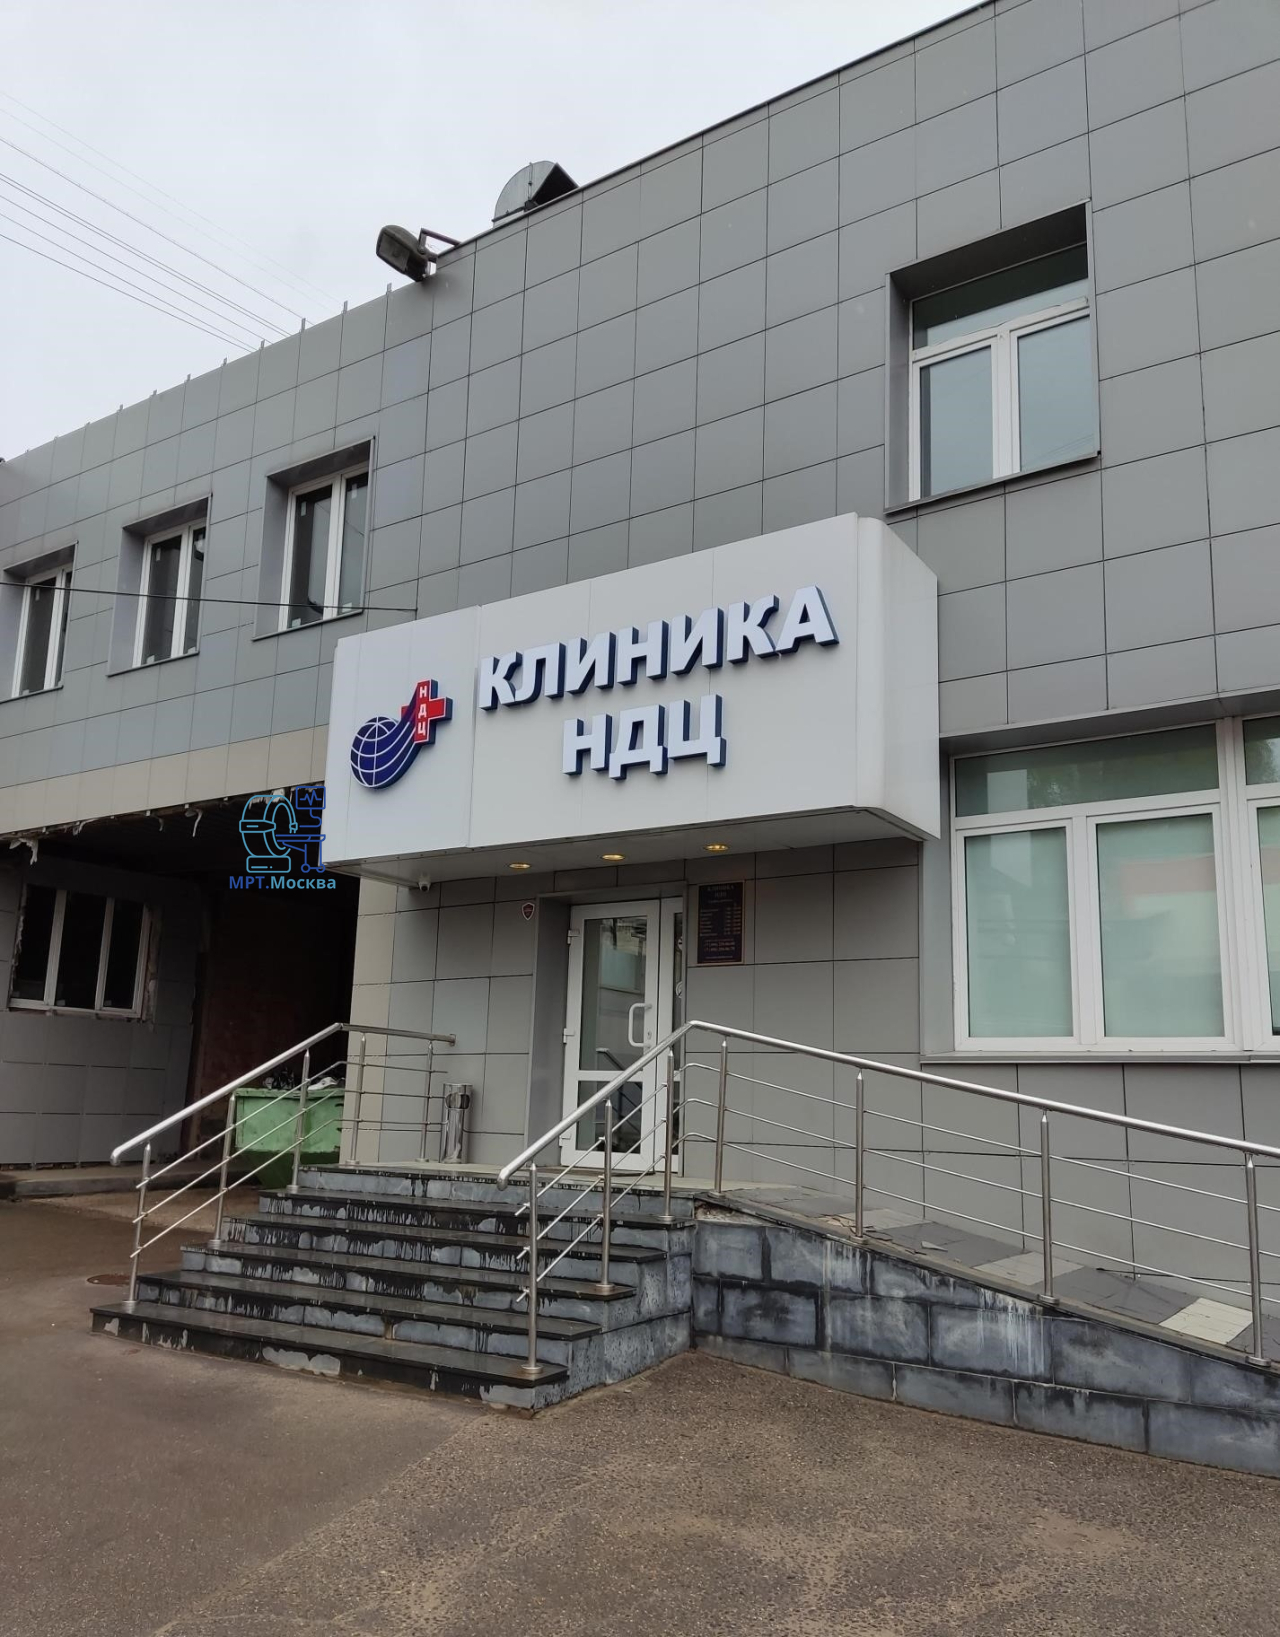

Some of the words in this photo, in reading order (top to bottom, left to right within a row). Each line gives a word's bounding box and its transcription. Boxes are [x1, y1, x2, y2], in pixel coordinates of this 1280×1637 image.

[478, 584, 840, 711] КЛИНИКА
[418, 685, 428, 736] НДЦ
[562, 693, 727, 780] НДЦ
